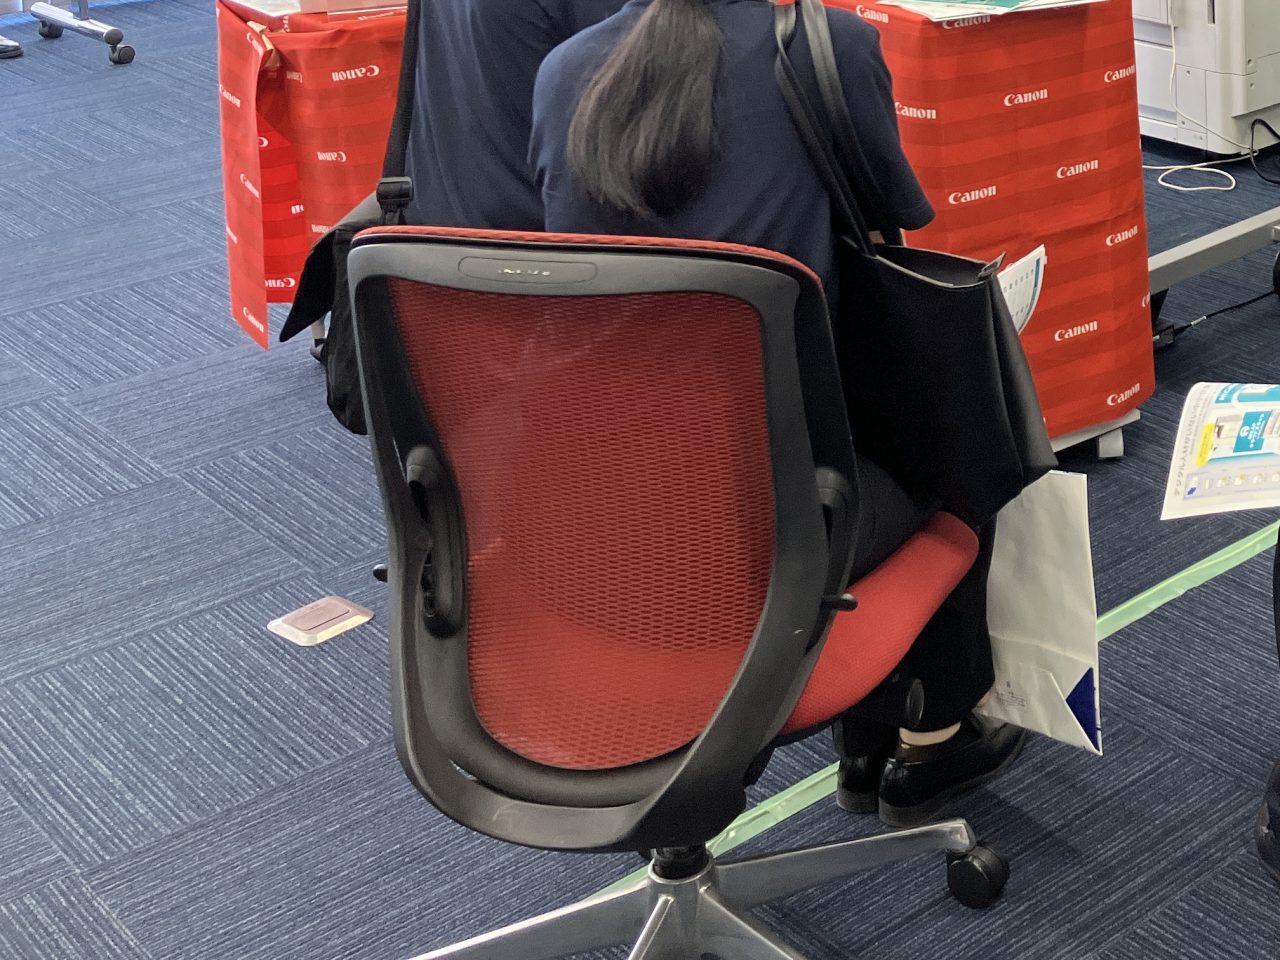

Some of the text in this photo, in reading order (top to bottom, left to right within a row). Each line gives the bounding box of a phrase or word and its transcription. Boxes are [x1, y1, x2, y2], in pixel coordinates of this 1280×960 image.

[856, 4, 889, 24] Canon
[331, 64, 381, 82] Canon
[1003, 87, 1049, 107] Canon
[895, 101, 938, 121] Canon
[1056, 158, 1099, 180] Canon
[948, 184, 997, 206] Canon
[1105, 224, 1139, 248] Canon
[1054, 320, 1099, 343] Canon
[1106, 381, 1142, 407] Canon
